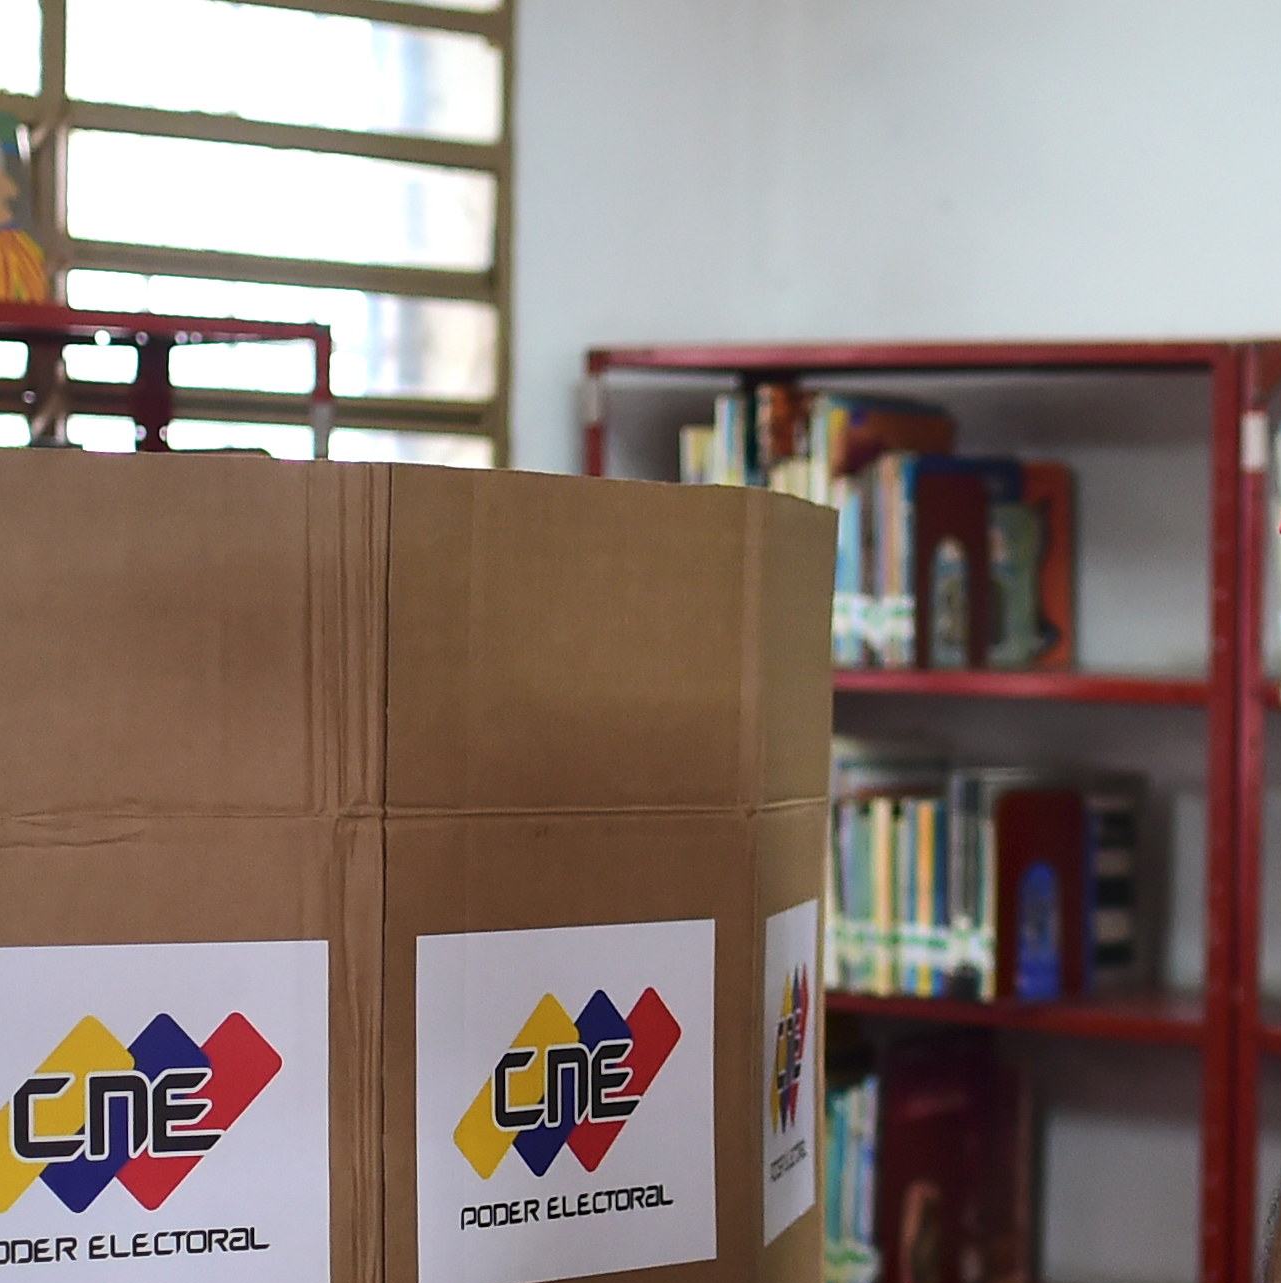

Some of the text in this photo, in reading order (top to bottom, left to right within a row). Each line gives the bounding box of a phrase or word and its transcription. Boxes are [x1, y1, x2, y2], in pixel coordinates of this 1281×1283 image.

[12, 1071, 223, 1160] CNE
[494, 1041, 641, 1128] CNE
[460, 1184, 674, 1231] PODER ELECTORAL
[88, 1226, 271, 1261] ELECTORAL
